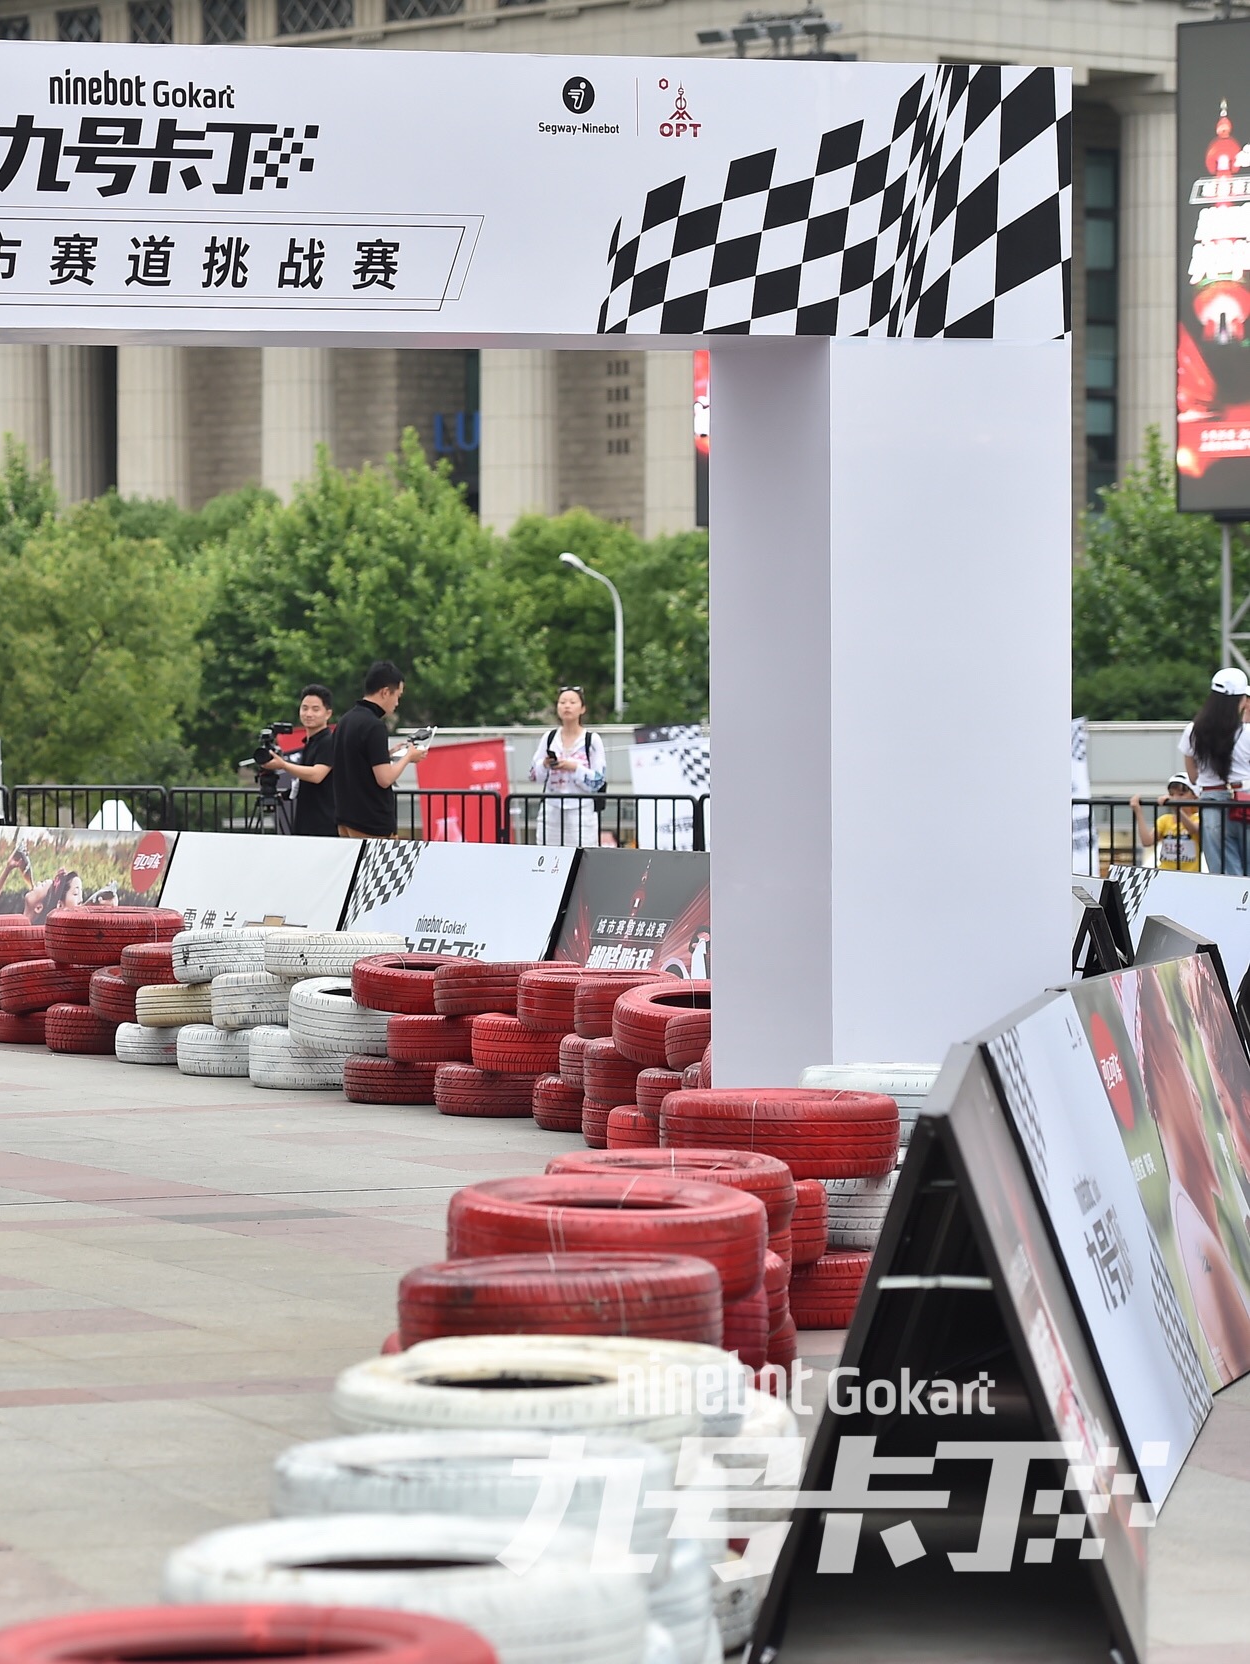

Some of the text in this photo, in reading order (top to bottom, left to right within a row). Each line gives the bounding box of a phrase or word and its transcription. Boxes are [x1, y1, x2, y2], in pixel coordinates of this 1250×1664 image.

[49, 69, 236, 110] ninebot Gokart
[538, 122, 620, 135] Segway-Ninebot
[658, 122, 701, 138] OPT
[415, 914, 467, 935] ninebot Gokart
[596, 918, 667, 938] 城市赛道挑战赛
